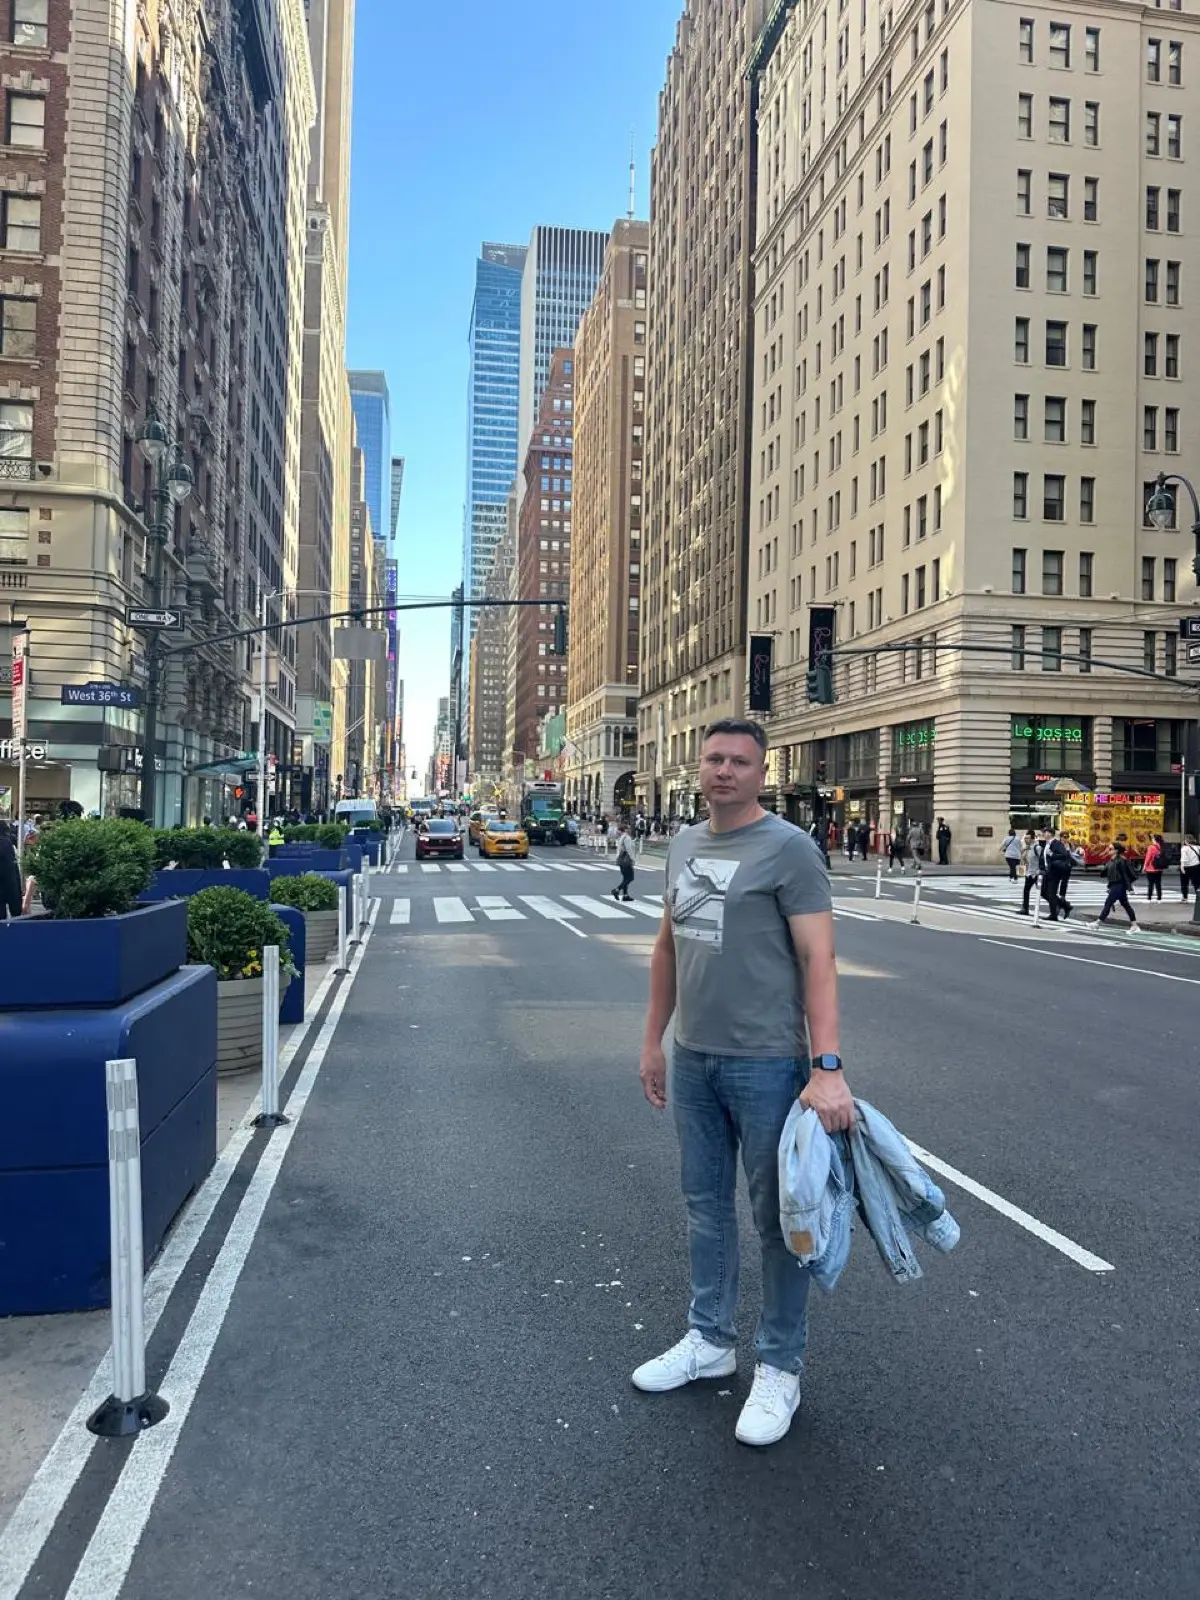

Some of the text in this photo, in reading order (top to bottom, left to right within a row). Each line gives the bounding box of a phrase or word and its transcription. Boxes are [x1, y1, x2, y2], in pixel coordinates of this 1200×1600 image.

[68, 689, 132, 702] West 36th St
[1014, 724, 1082, 741] Legasea
